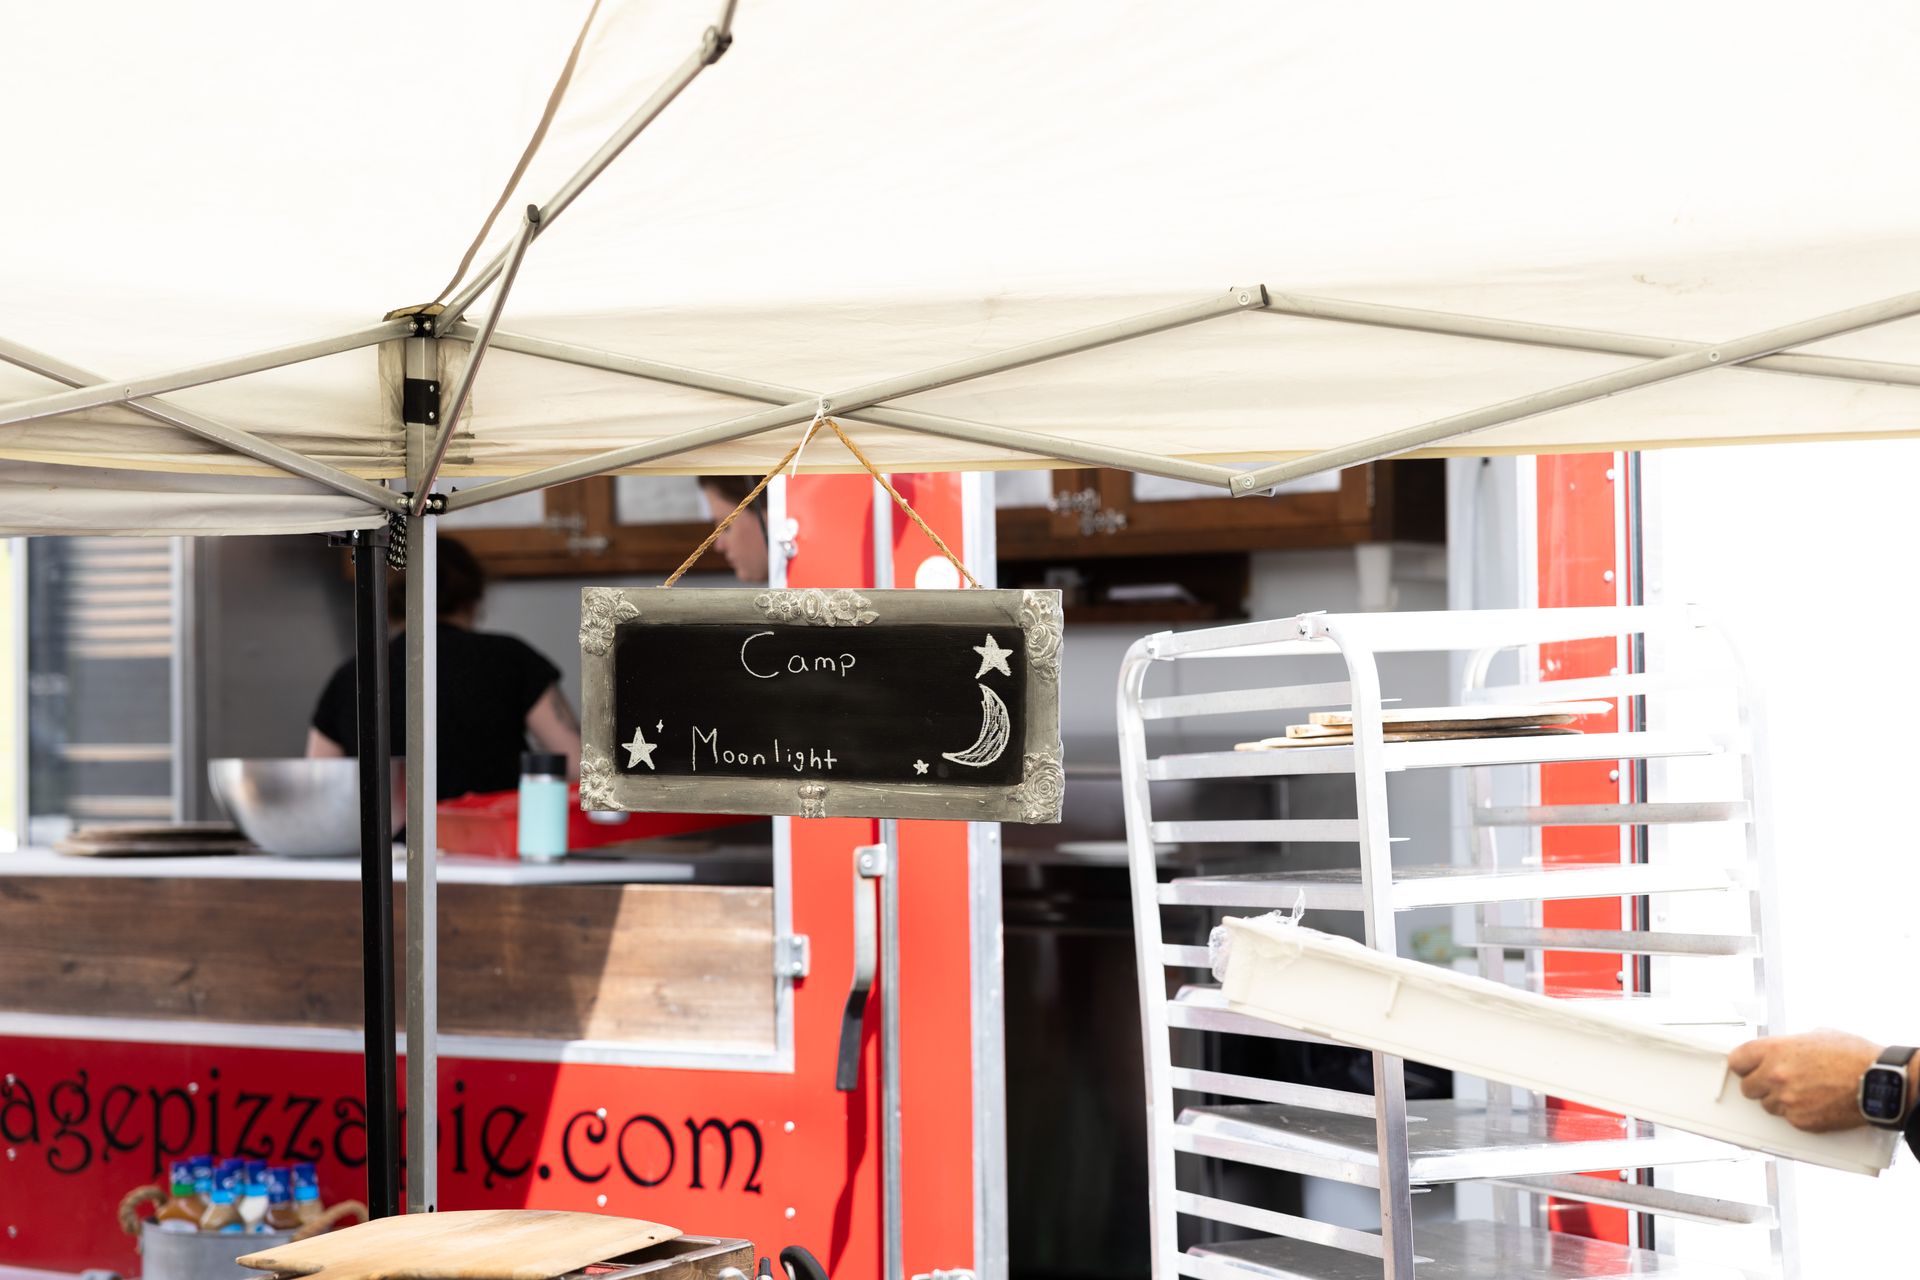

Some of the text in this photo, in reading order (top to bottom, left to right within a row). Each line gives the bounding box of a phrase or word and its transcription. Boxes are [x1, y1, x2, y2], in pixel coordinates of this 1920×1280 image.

[740, 630, 857, 679] Camp
[691, 725, 838, 772] Moonlight
[0, 1066, 764, 1194] agepizzaie.com
